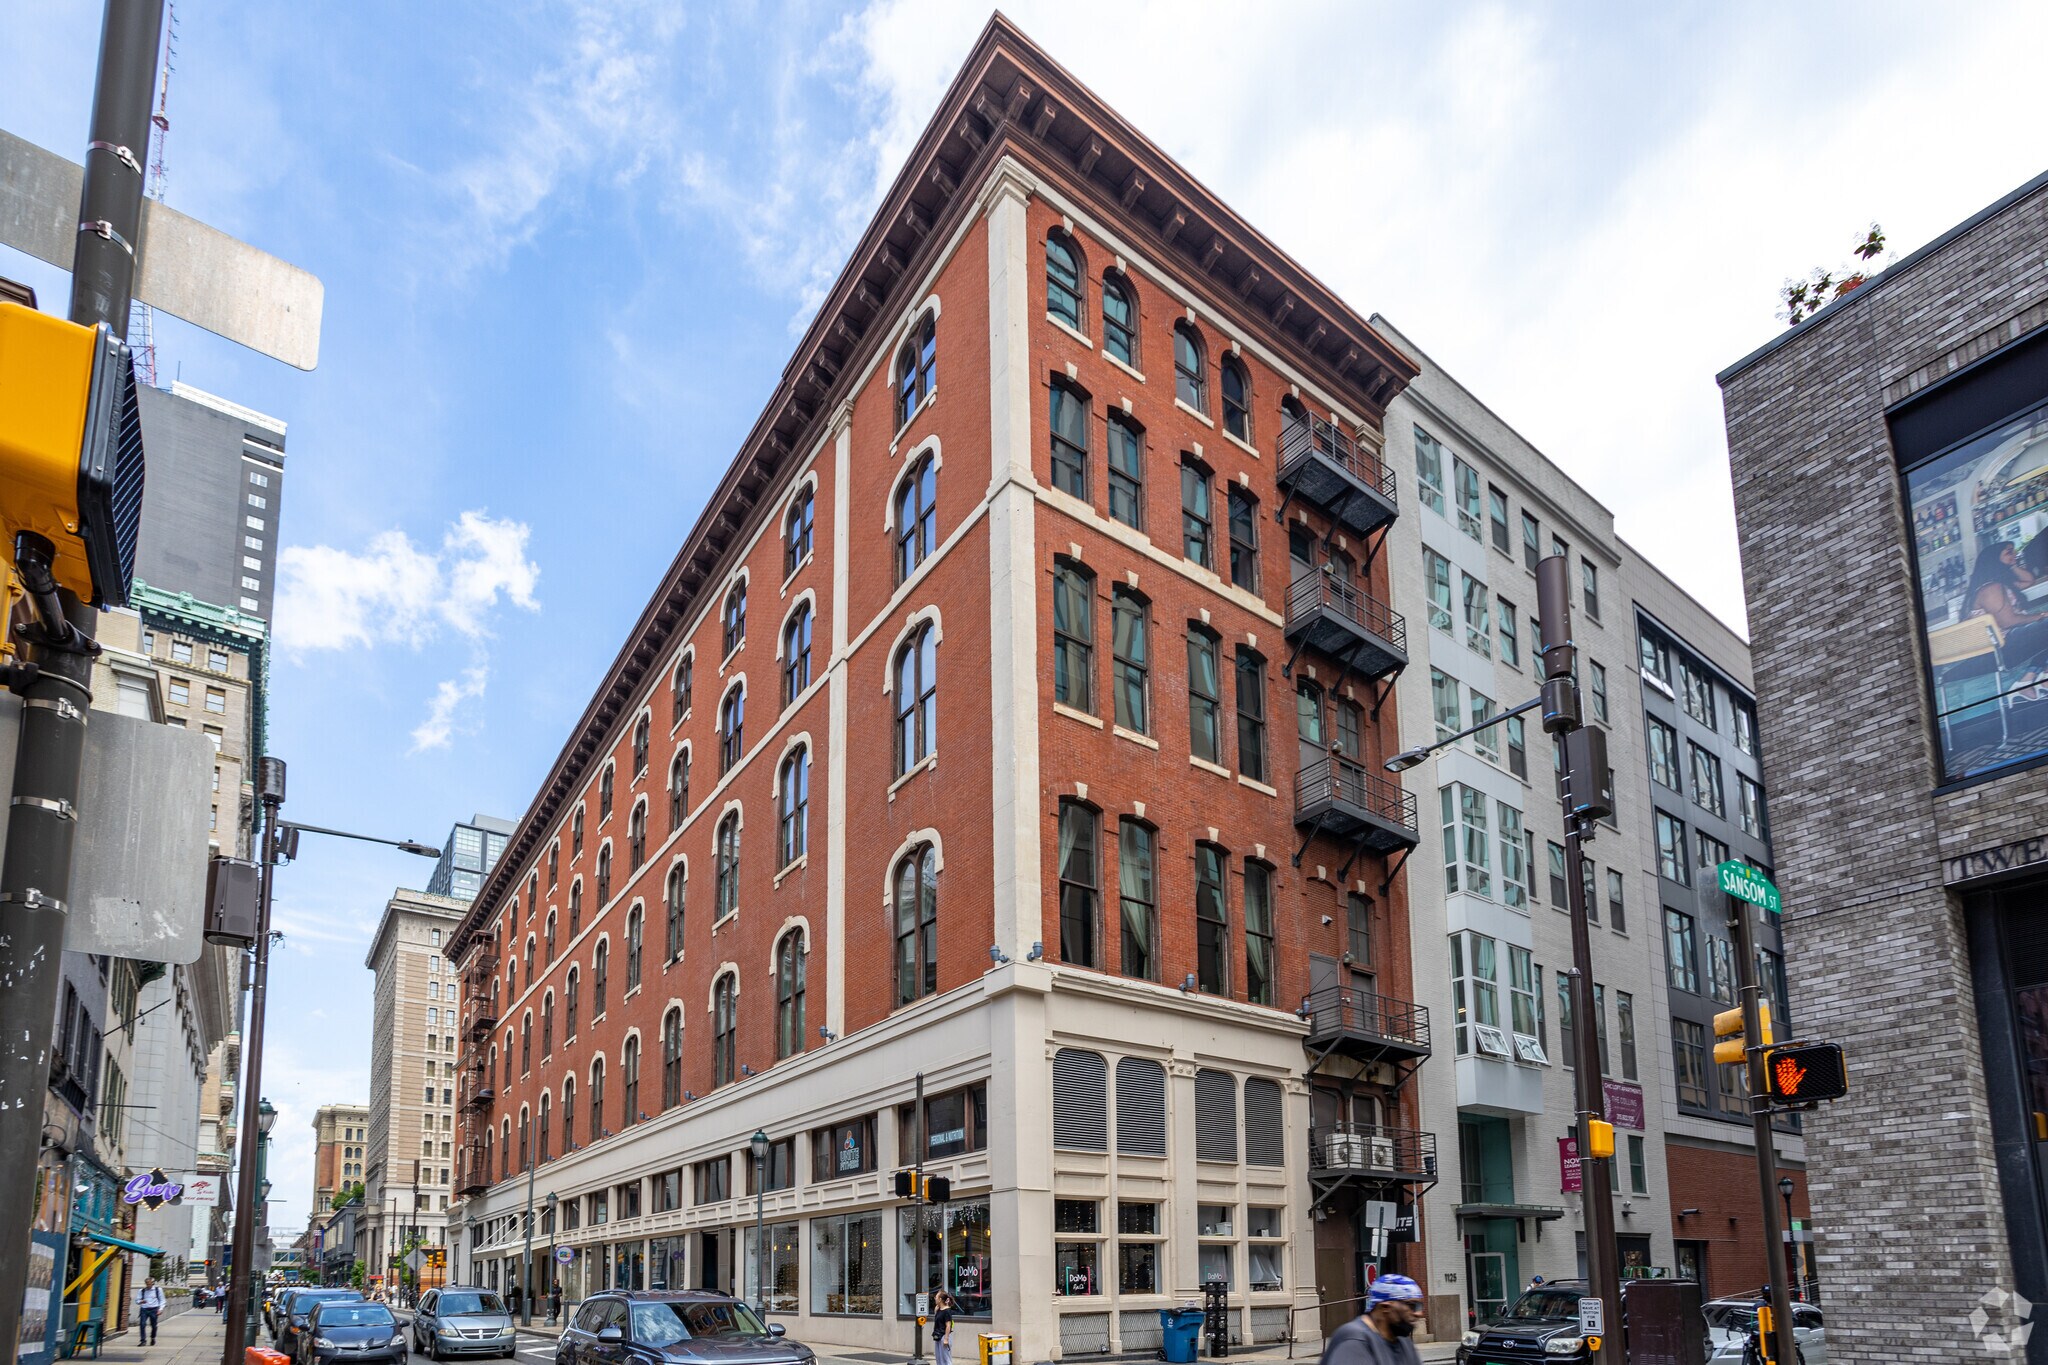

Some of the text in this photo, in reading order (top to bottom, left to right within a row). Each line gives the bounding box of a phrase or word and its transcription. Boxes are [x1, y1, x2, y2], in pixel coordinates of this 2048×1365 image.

[1723, 869, 1777, 909] SANSOM ST
[840, 1147, 860, 1162] UNITE
[1396, 1216, 1413, 1227] ITE
[1444, 1273, 1457, 1282] 1125
